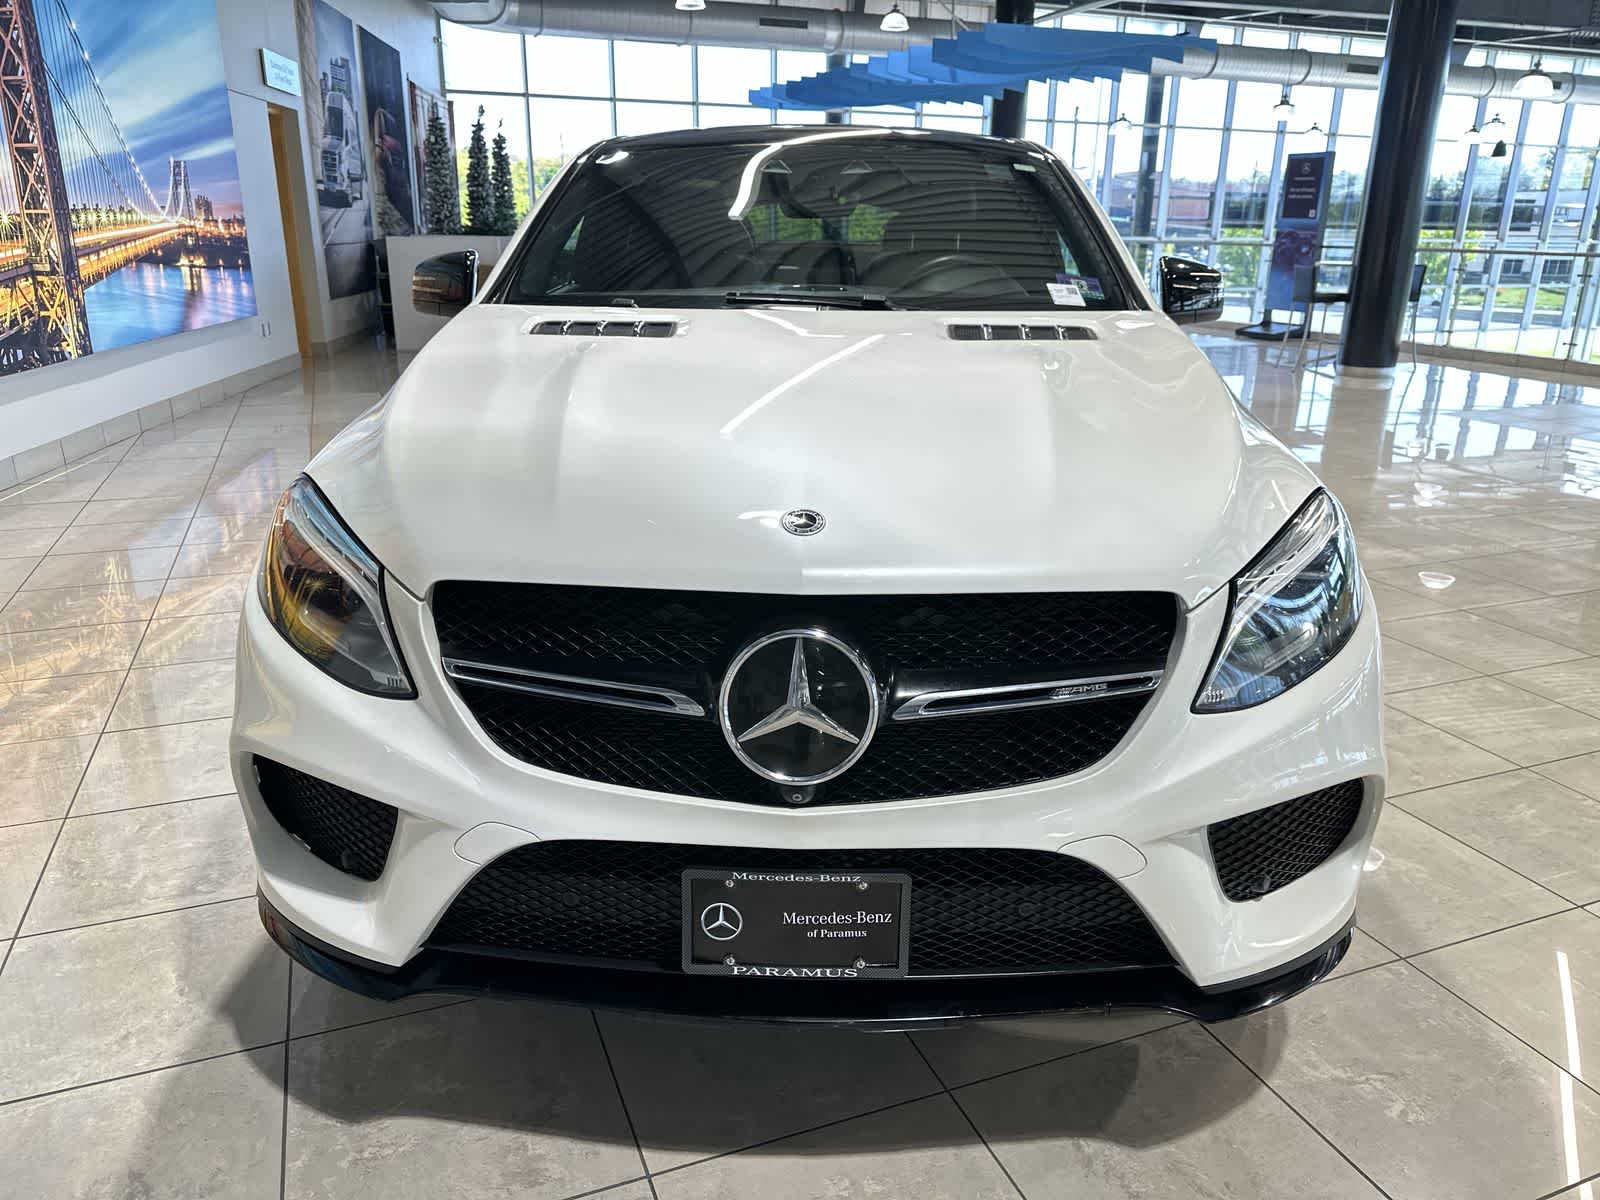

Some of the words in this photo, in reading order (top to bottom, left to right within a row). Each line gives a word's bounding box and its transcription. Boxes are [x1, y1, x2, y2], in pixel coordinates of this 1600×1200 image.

[1072, 683, 1107, 693] AMG
[731, 872, 861, 883] Mercedes-Benz
[783, 911, 892, 925] Mercedes-Benz
[807, 929, 817, 938] of
[820, 929, 867, 938] Paramus
[731, 966, 858, 978] PARAMUS
